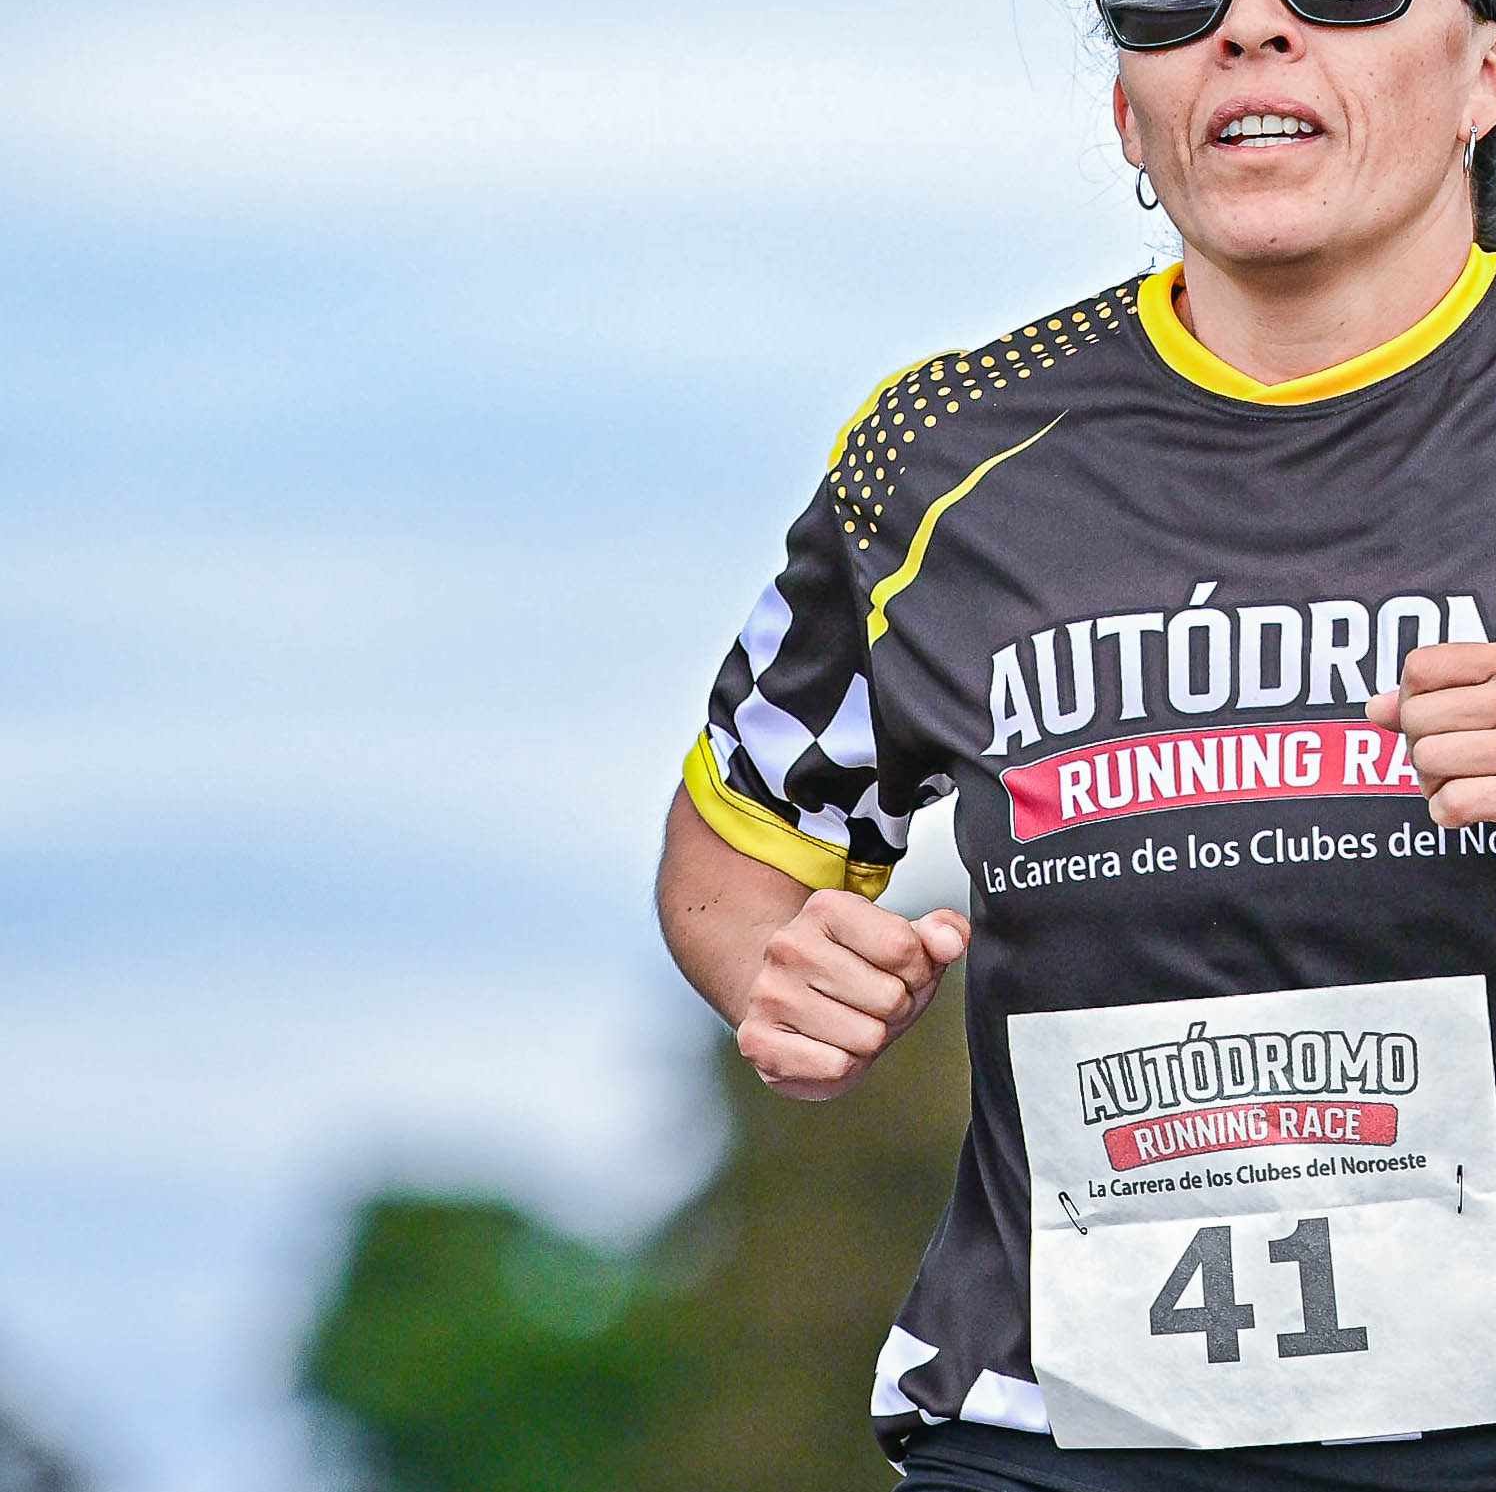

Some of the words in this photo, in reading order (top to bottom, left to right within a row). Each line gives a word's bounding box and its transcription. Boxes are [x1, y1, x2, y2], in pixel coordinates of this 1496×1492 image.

[1057, 729, 1323, 821] RUNNING
[982, 860, 1008, 894] La
[1009, 850, 1122, 890] Carrera
[1131, 838, 1178, 874] de
[1188, 834, 1241, 869] los
[1250, 827, 1378, 864] Clubes
[1388, 821, 1446, 858] del
[1077, 1021, 1418, 1125] AUTÓDROMO
[1132, 1107, 1269, 1161] RUNNING
[1279, 1106, 1362, 1141] RACE
[1088, 1179, 1107, 1199] La
[1110, 1176, 1176, 1197] Carrera
[1179, 1168, 1203, 1191] de
[1206, 1167, 1233, 1189] los
[1236, 1161, 1301, 1186] Clubes
[1306, 1156, 1337, 1178] del
[1341, 1151, 1428, 1175] Noroeste
[1149, 1216, 1369, 1365] 41
